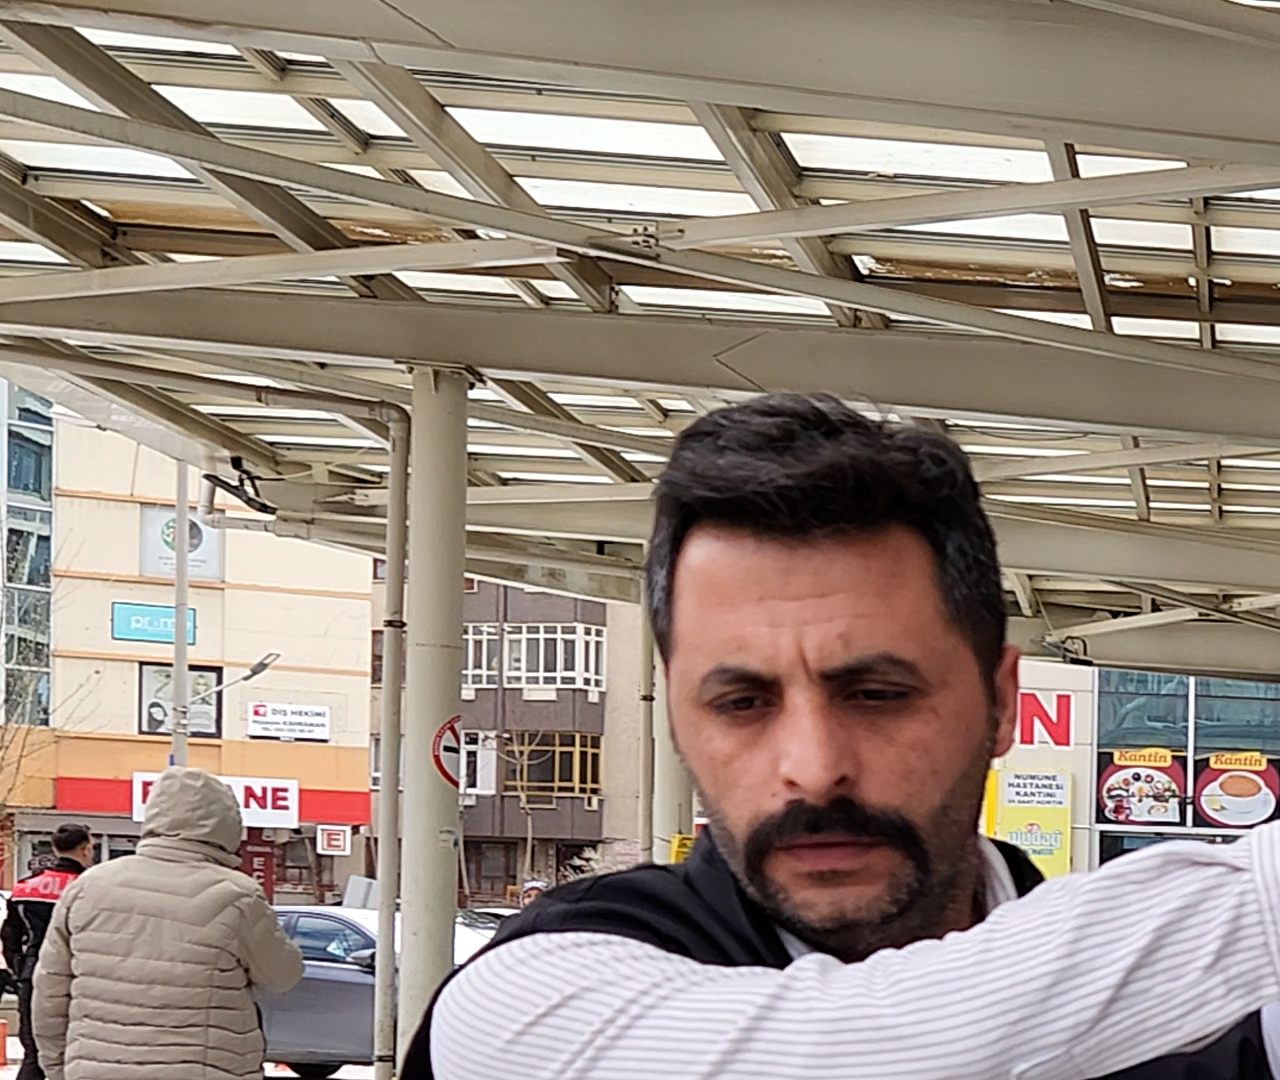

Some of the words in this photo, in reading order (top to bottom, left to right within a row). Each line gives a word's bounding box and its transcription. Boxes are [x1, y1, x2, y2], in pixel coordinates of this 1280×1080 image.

[1117, 750, 1168, 764] Kantin
[1213, 754, 1264, 769] Kantin
[327, 832, 342, 848] E
